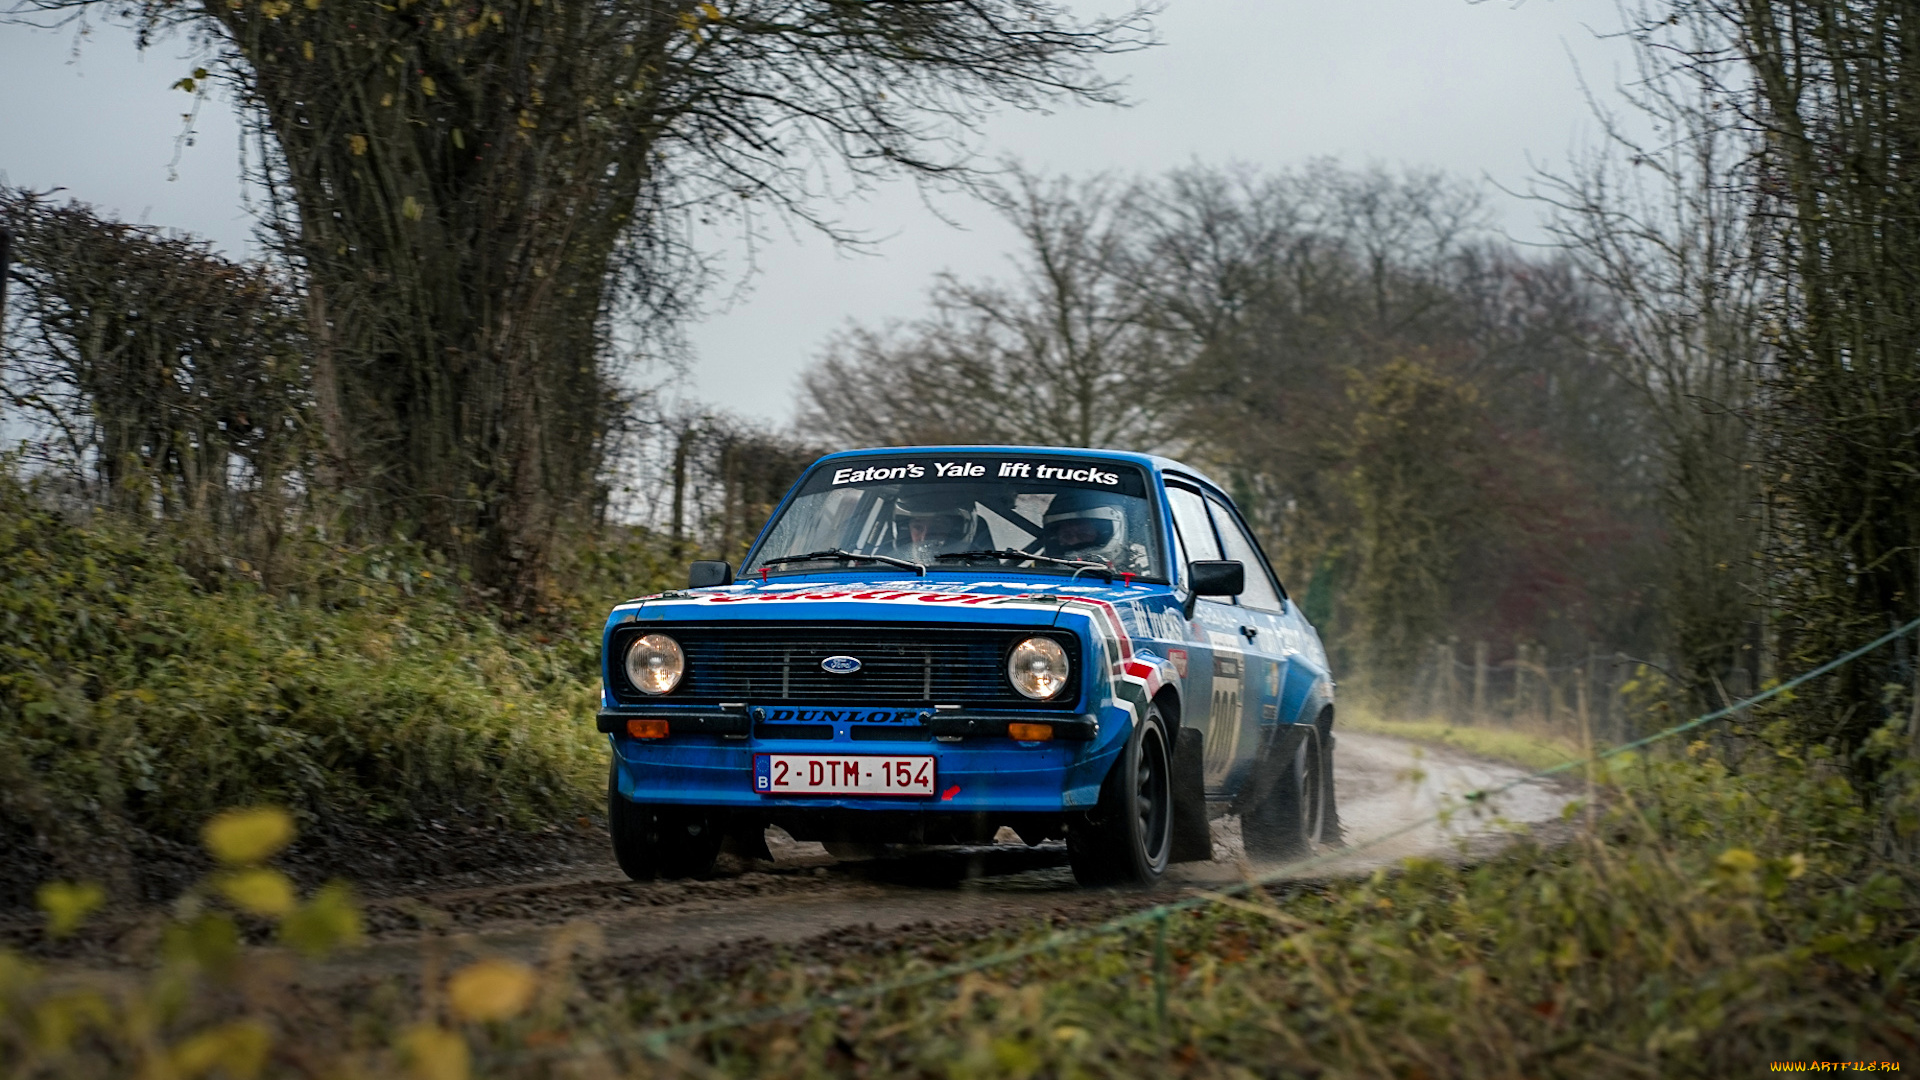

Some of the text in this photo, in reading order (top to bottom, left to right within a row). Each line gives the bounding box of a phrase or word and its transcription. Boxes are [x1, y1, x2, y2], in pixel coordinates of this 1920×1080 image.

[832, 461, 1119, 486] Eaton's Yale lift trucks
[768, 709, 917, 723] DUNLOP
[758, 776, 769, 789] B
